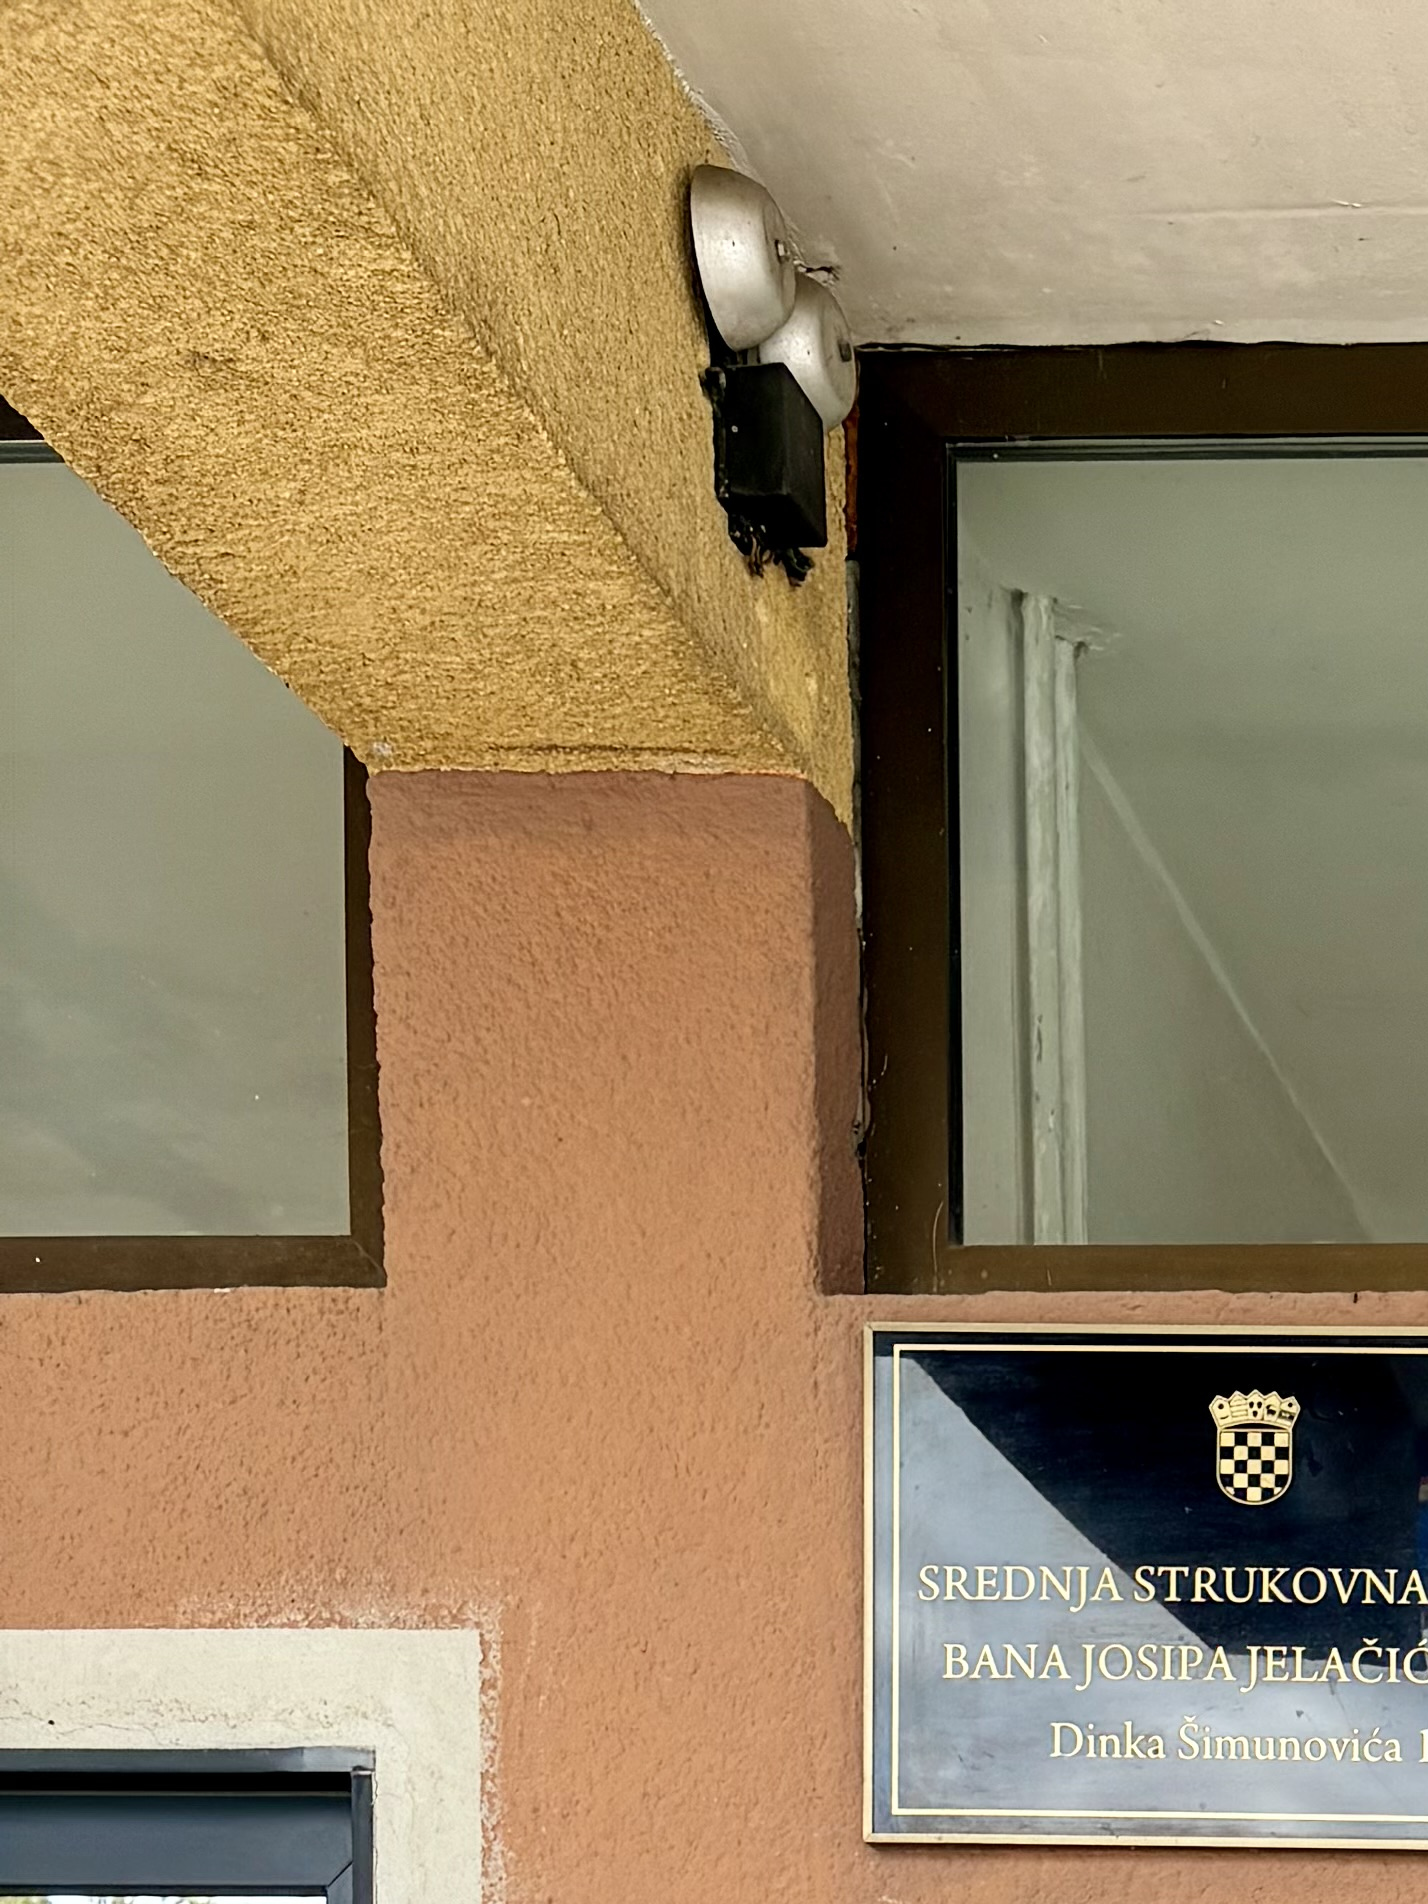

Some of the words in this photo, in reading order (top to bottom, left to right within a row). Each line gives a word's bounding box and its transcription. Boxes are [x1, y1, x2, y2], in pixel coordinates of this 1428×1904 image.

[917, 1564, 1124, 1613] SREDNJA
[942, 1642, 1072, 1680] BANA
[1075, 1643, 1237, 1692] JOSIPA
[1049, 1720, 1166, 1759] Dinka
[1177, 1715, 1403, 1763] Šimunovića
